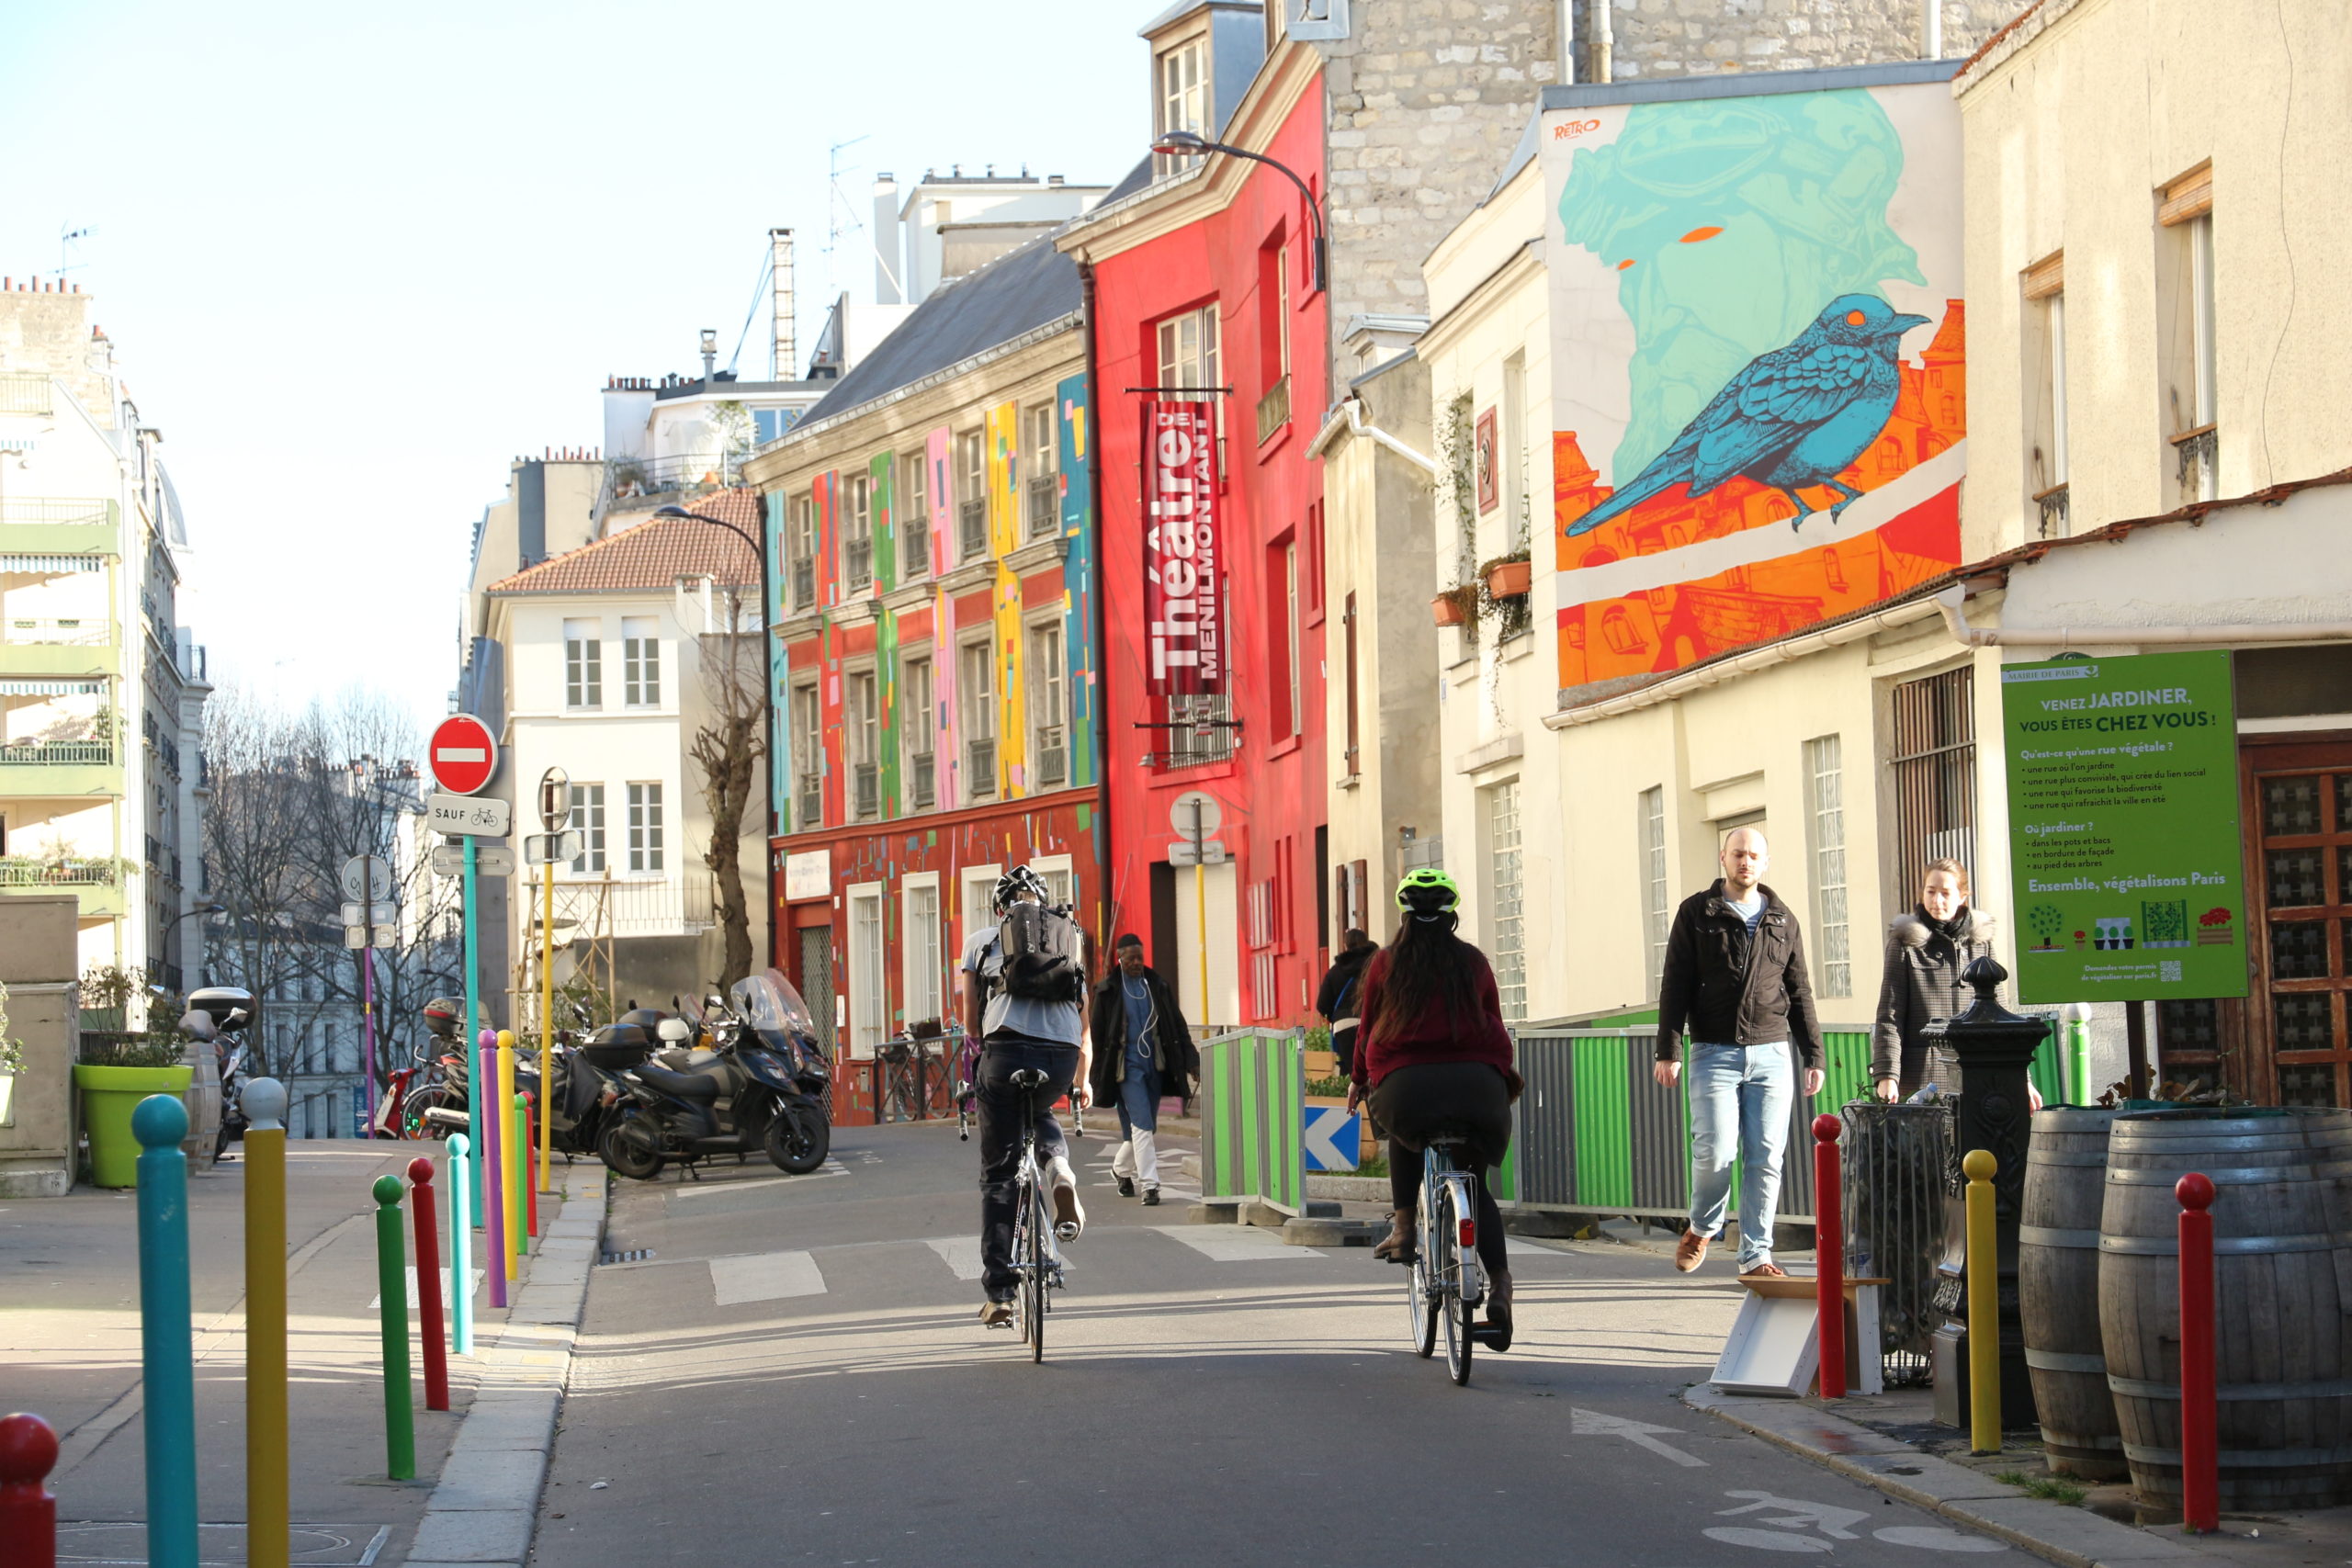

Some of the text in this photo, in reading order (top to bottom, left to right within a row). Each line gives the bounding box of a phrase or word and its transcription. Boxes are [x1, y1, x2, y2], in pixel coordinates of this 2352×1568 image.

[1554, 118, 1600, 141] RETRO
[1157, 412, 1189, 427] DE
[1148, 430, 1197, 680] Théâtre
[1193, 418, 1216, 680] MENILMONTANT
[2055, 669, 2079, 677] PARIS
[2041, 688, 2192, 711] VENEZ JARDINER,
[2019, 720, 2058, 732] VOUS
[2062, 716, 2092, 730] ÊTES
[2096, 715, 2147, 732] CHEZ
[2152, 711, 2208, 728] VOUS
[2020, 750, 2064, 761] Qu'est-ce
[2064, 747, 2096, 759] qu'une
[2098, 746, 2117, 754] rue
[2119, 741, 2165, 757] végétale
[2059, 763, 2069, 772] où
[2071, 762, 2086, 771] l'on
[2086, 761, 2114, 773] jardine
[2060, 775, 2075, 786] plus
[2078, 773, 2119, 783] conviviale,
[2184, 768, 2205, 777] social
[2061, 790, 2073, 798] qui
[2108, 784, 2114, 793] la
[2117, 784, 2162, 793] biodiversité
[2061, 800, 2073, 810] qui
[435, 808, 466, 819] SAUF
[2025, 825, 2040, 834] Où
[2040, 821, 2086, 837] jardiner
[2064, 839, 2081, 848] pots
[2044, 849, 2075, 857] bordure
[2088, 847, 2114, 857] façade
[2044, 861, 2061, 872] pied
[2063, 860, 2076, 868] des
[2078, 859, 2102, 867] arbres
[2029, 872, 2225, 894] Ensemble, végétalisons Paris
